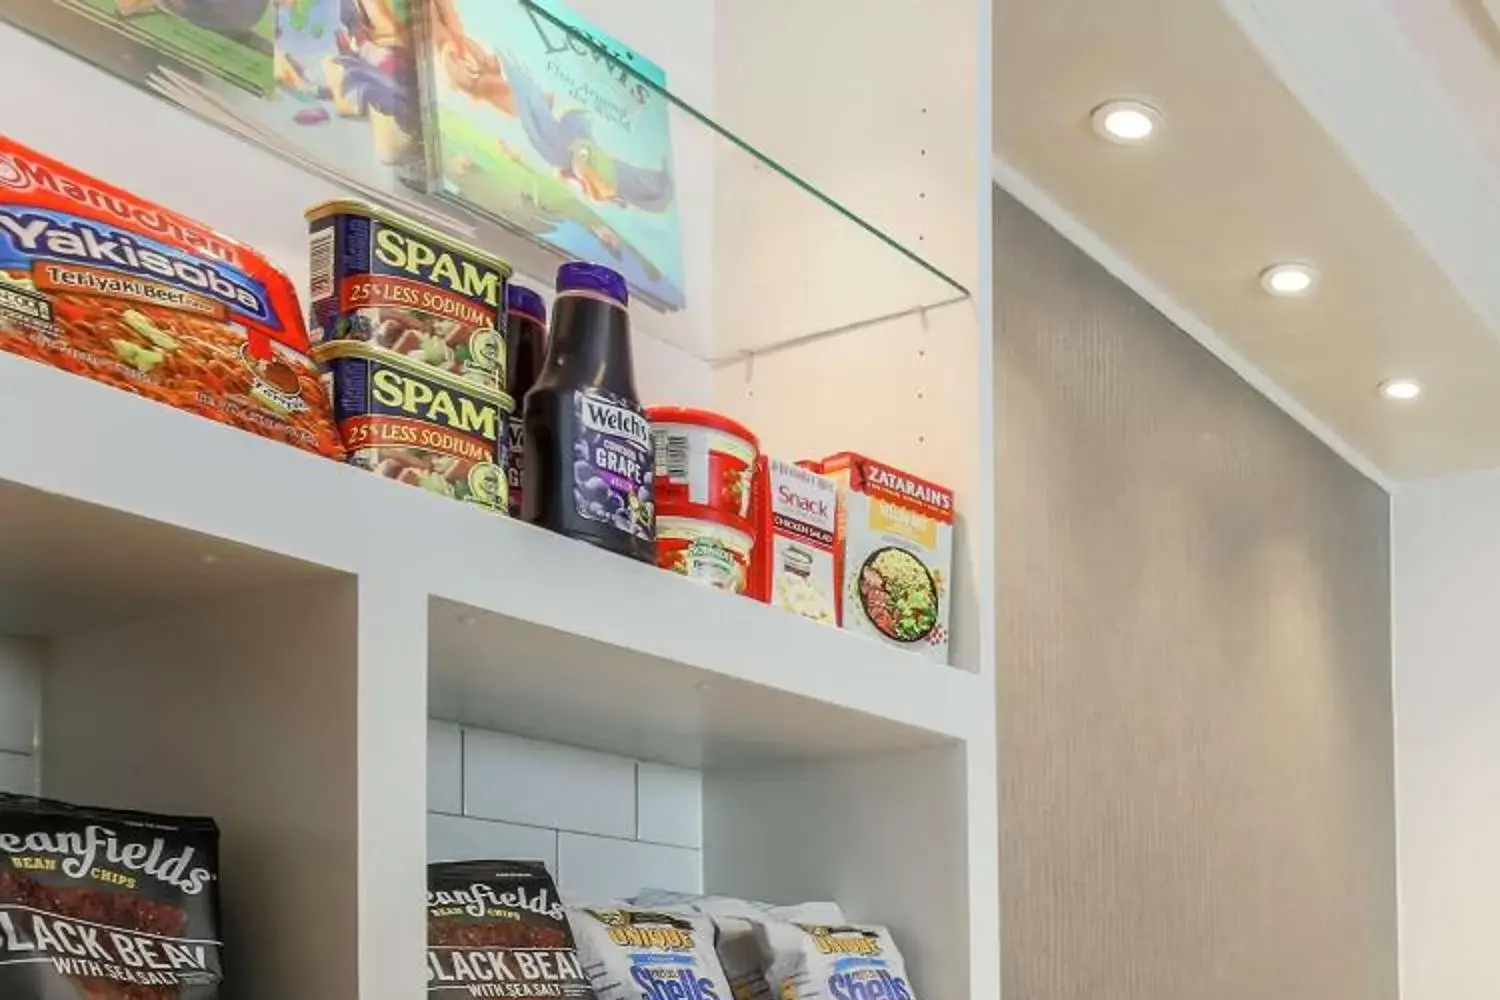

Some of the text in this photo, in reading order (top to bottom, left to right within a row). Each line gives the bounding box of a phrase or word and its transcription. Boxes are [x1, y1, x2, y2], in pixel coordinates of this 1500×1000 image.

[0, 213, 260, 313] Yakisoba
[375, 227, 499, 306] SPAM
[48, 265, 185, 305] Teriyaki Beef
[384, 283, 421, 305] LESS
[421, 292, 484, 327] SODIUM
[372, 368, 498, 441] SPAM
[587, 404, 647, 440] Welch's
[381, 423, 418, 443] LESS
[420, 429, 484, 461] SODIUM
[595, 447, 641, 484] GRAPE
[778, 484, 829, 519] Snack
[773, 516, 810, 537] CHICKEN
[11, 856, 137, 889] BEAN CHIPS
[606, 924, 695, 949] UNIQUE
[52, 957, 180, 986] WITH SEA SALT
[468, 983, 562, 998] WITH SEA SALT
